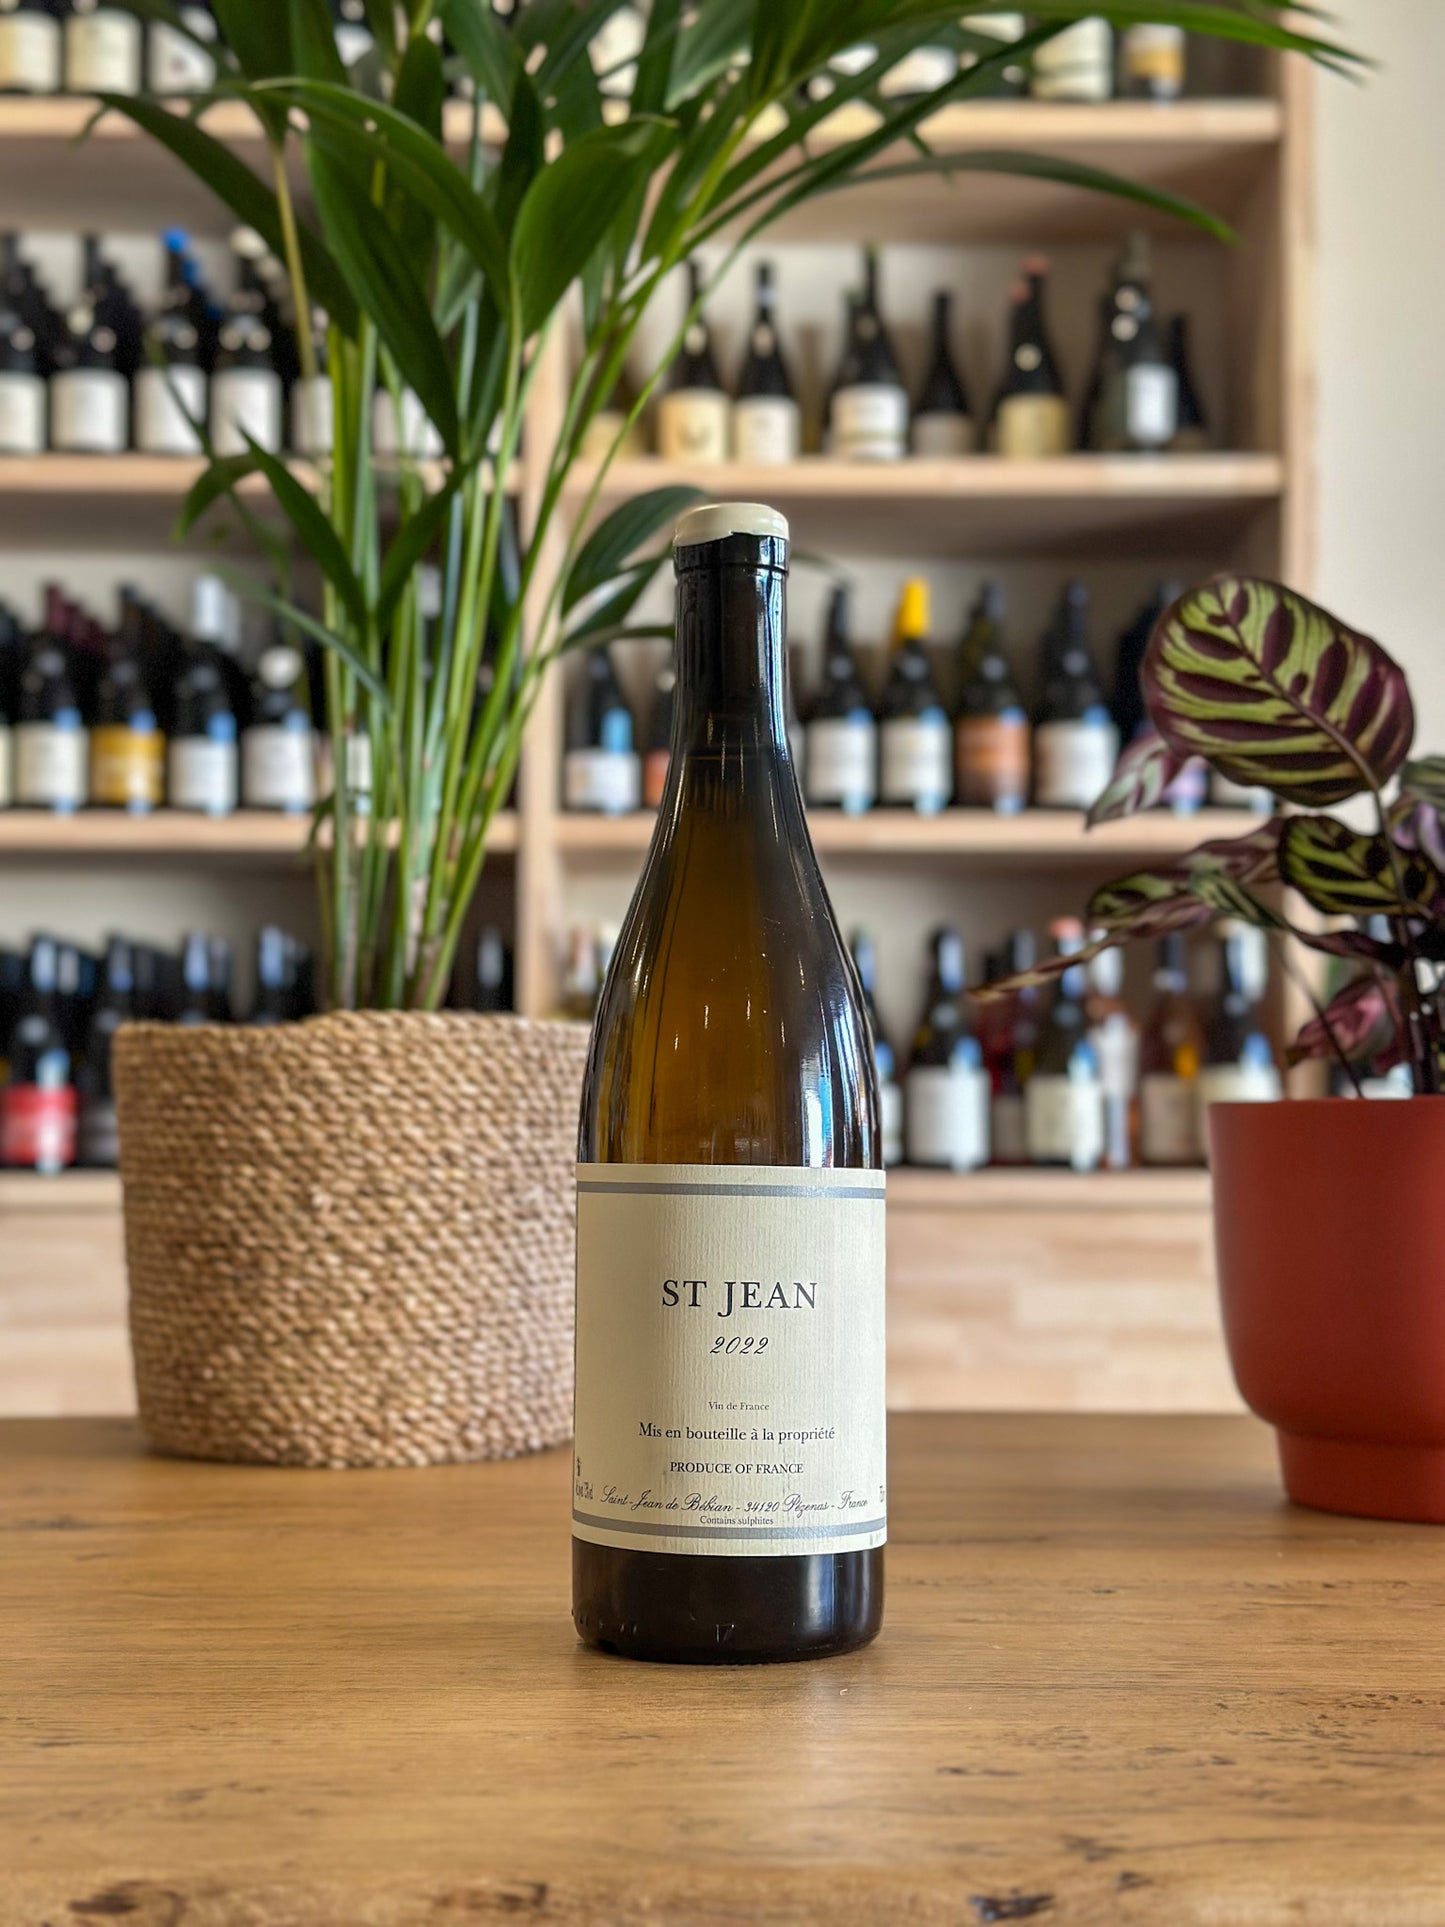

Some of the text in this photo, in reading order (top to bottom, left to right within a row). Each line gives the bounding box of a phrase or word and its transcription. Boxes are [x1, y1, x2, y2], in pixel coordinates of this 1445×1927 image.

[662, 1279, 818, 1318] ST JEAN
[709, 1336, 769, 1355] 2022
[708, 1401, 770, 1411] Vin de France
[639, 1422, 836, 1445] Mis en bouteille à la propriété
[669, 1461, 804, 1475] PRODUCE OF FRANCE
[665, 1498, 680, 1511] de
[743, 1501, 780, 1513] 34120
[837, 1490, 869, 1510] France
[700, 1515, 774, 1526] Contains sulphites
